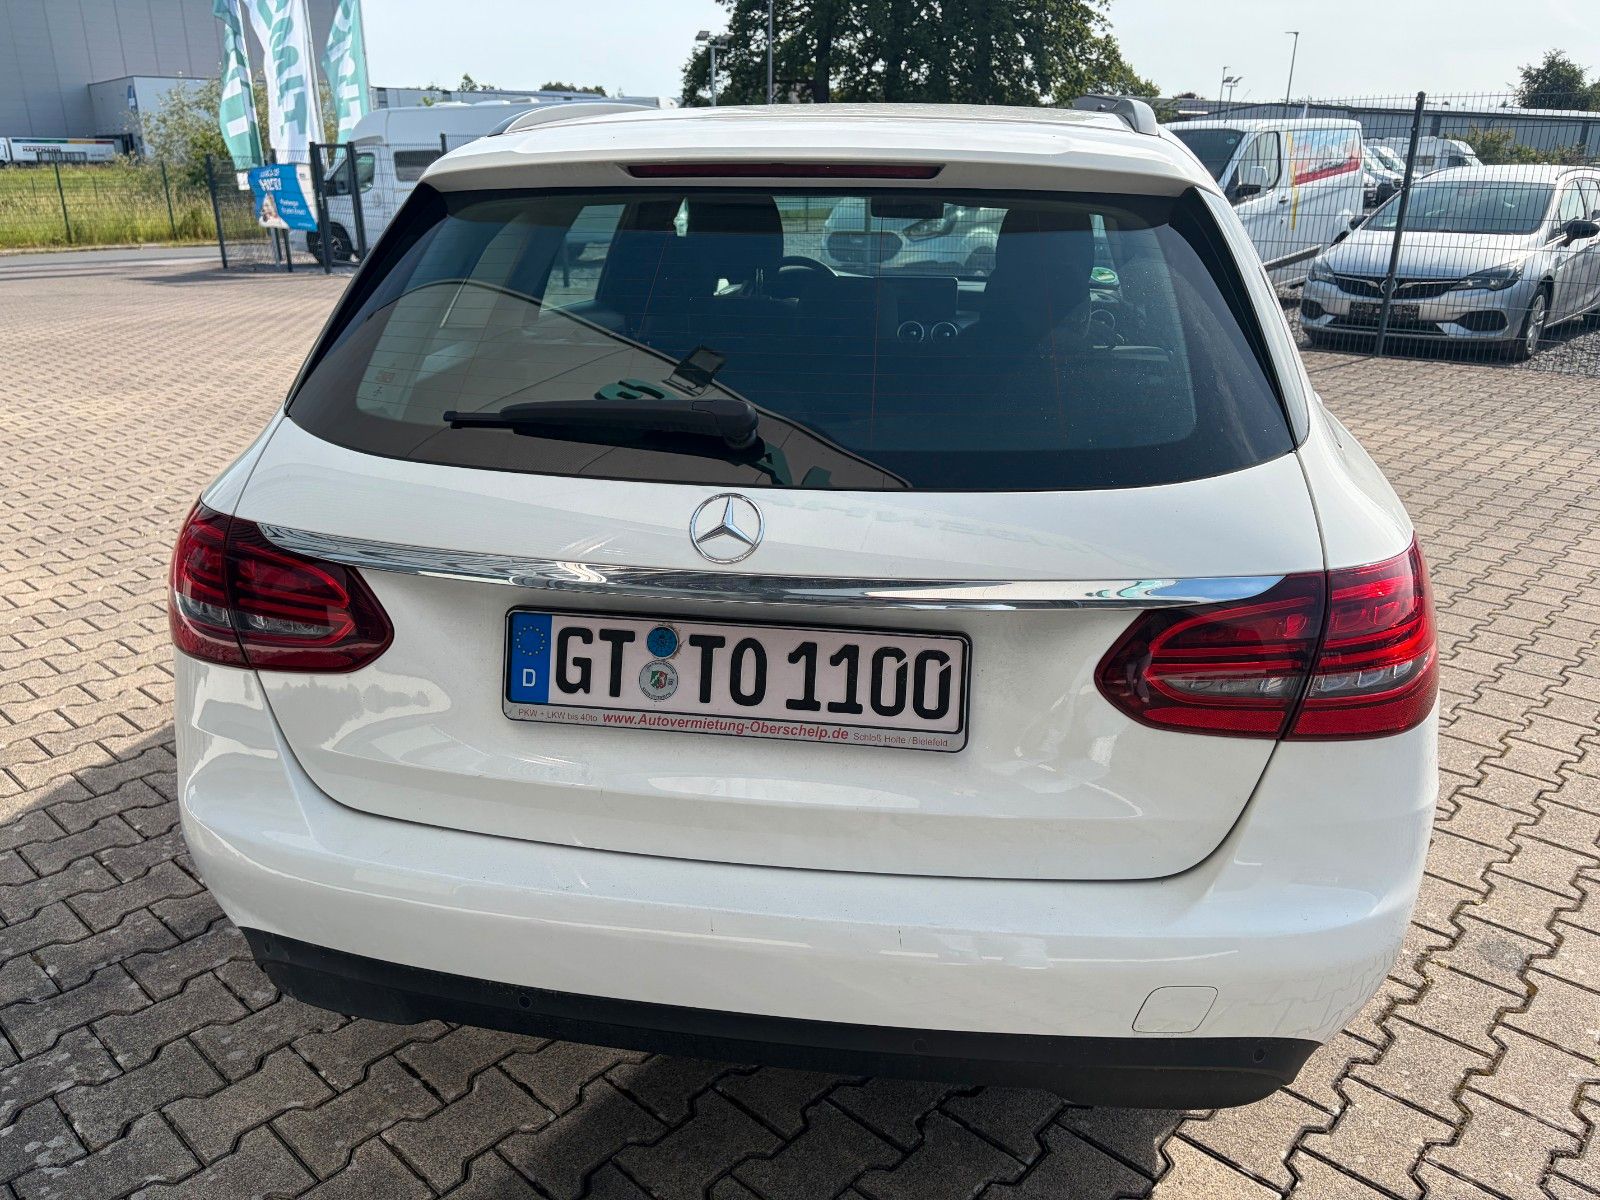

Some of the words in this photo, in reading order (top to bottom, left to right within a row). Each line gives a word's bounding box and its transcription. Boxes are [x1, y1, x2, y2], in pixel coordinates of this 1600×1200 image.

[522, 668, 536, 687] D
[555, 626, 636, 698] GT
[688, 634, 768, 707] TO
[785, 641, 951, 720] 1100
[518, 708, 538, 717] PKW
[547, 711, 566, 720] LKW
[567, 712, 579, 721] bis
[580, 714, 598, 722] 40to
[602, 713, 849, 740] www.Autovermietung-Oberschelp.de
[884, 735, 906, 744] Holte
[912, 736, 948, 747] Bielefeld
